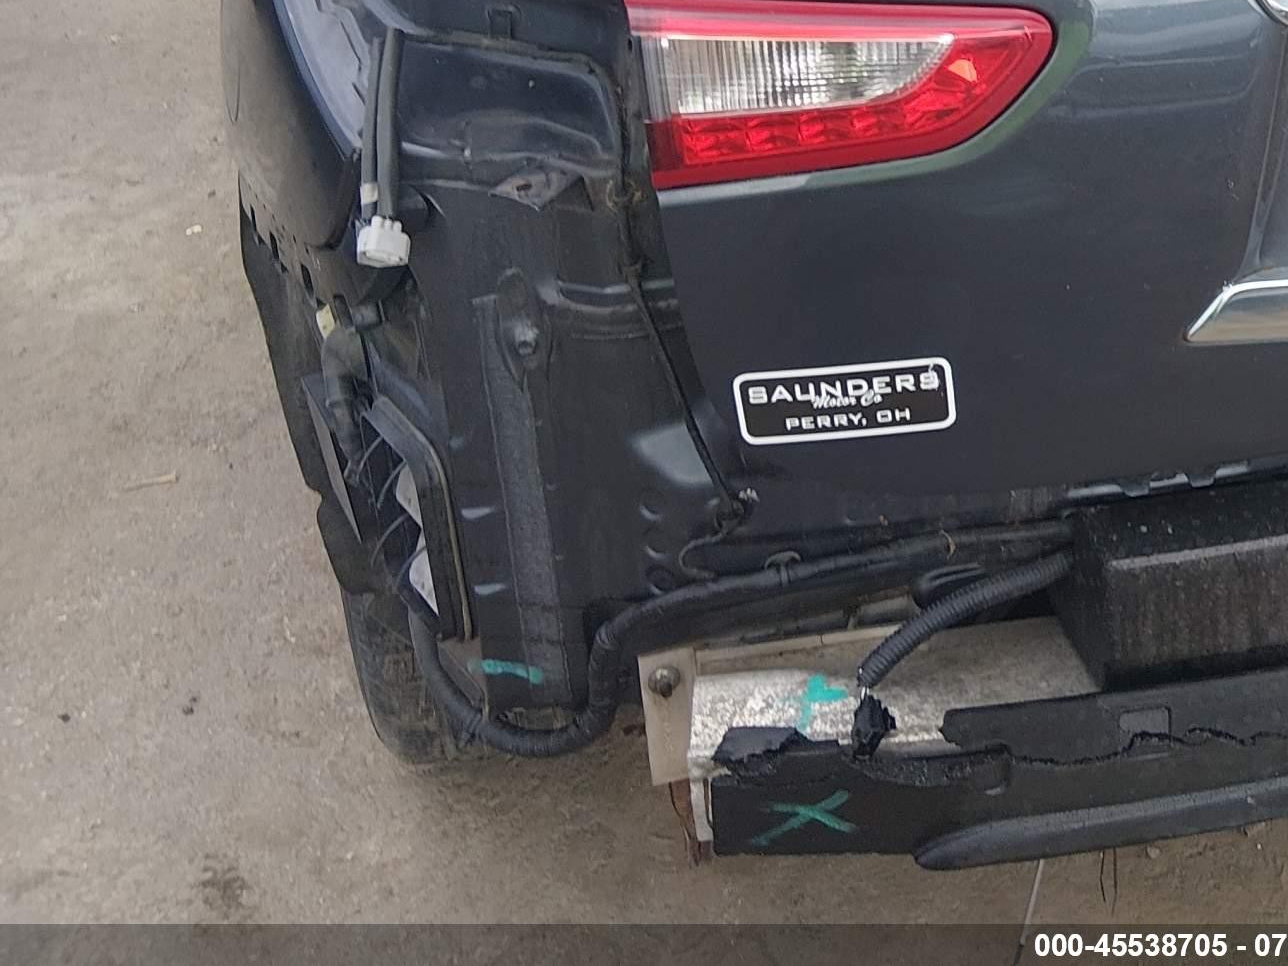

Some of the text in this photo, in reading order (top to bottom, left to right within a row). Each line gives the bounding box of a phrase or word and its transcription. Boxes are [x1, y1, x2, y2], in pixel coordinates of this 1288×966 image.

[747, 370, 940, 405] SAUNDERS
[784, 407, 912, 431] PERRY, OH
